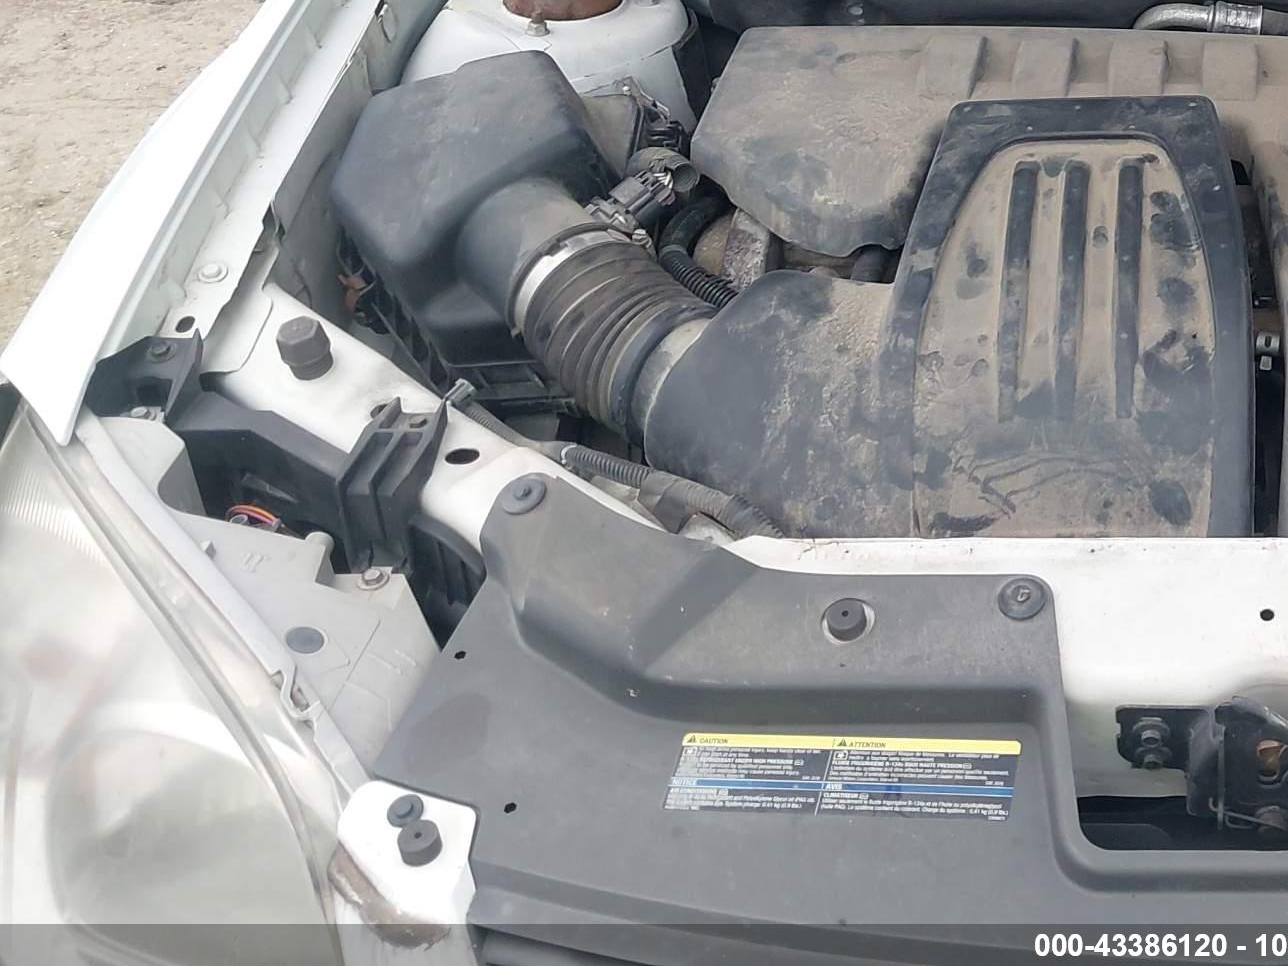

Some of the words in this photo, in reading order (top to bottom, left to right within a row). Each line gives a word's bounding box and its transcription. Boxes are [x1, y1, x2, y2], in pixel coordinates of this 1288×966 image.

[699, 737, 729, 745] CAUTION
[849, 740, 887, 749] ATTENTION
[671, 778, 698, 786] NOTICE
[825, 783, 843, 791] AVIS
